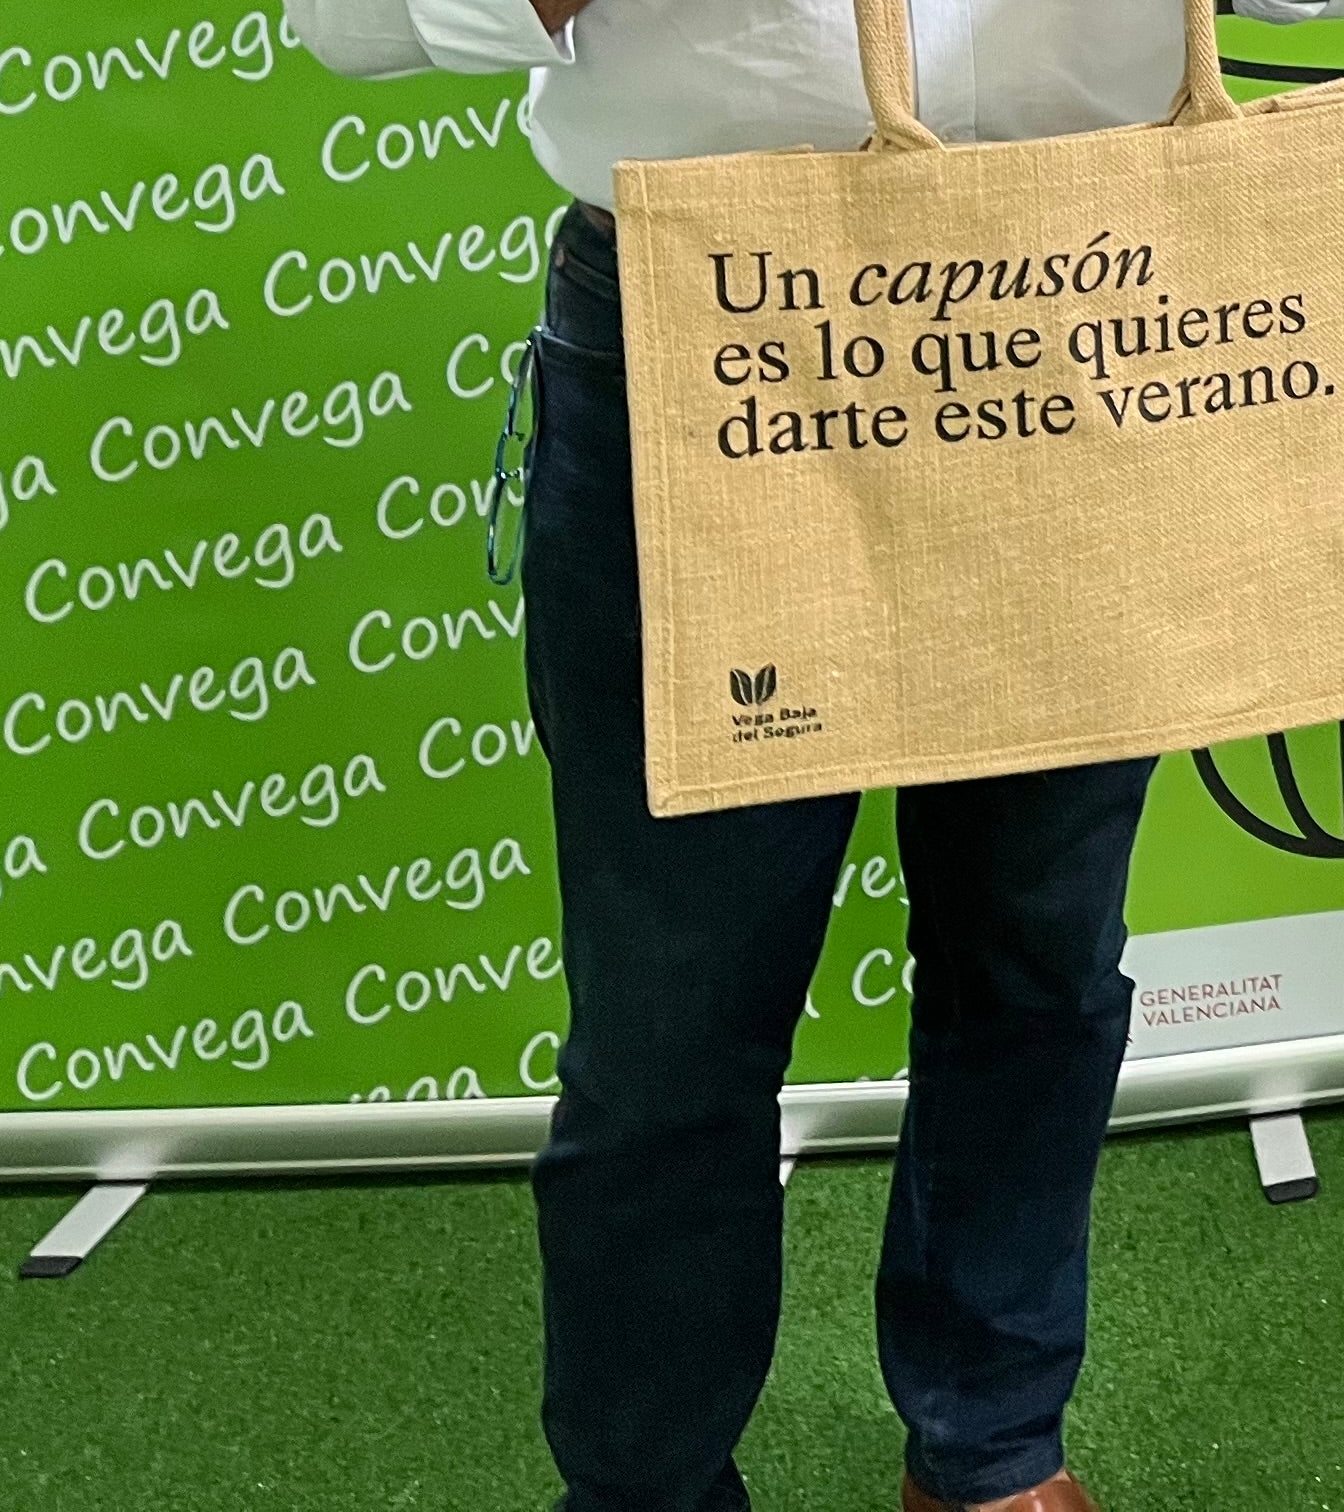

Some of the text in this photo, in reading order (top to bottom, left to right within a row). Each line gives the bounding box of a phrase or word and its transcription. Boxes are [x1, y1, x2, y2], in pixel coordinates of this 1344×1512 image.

[0, 153, 285, 260] onvega
[708, 231, 1154, 320] Un capusón
[0, 288, 229, 378] nvega
[712, 291, 1306, 392] es lo que quieres
[89, 370, 412, 482] Convega
[716, 357, 1336, 459] darte este verano.
[24, 512, 343, 623] Convega
[2, 645, 317, 757] Convega
[347, 596, 524, 675] Conv
[78, 752, 387, 861] Convega
[222, 837, 531, 947] Convega
[15, 935, 563, 1101] Convega Conve
[1140, 974, 1283, 1007] GENERALITAT
[1143, 996, 1282, 1027] VALENCIANA
